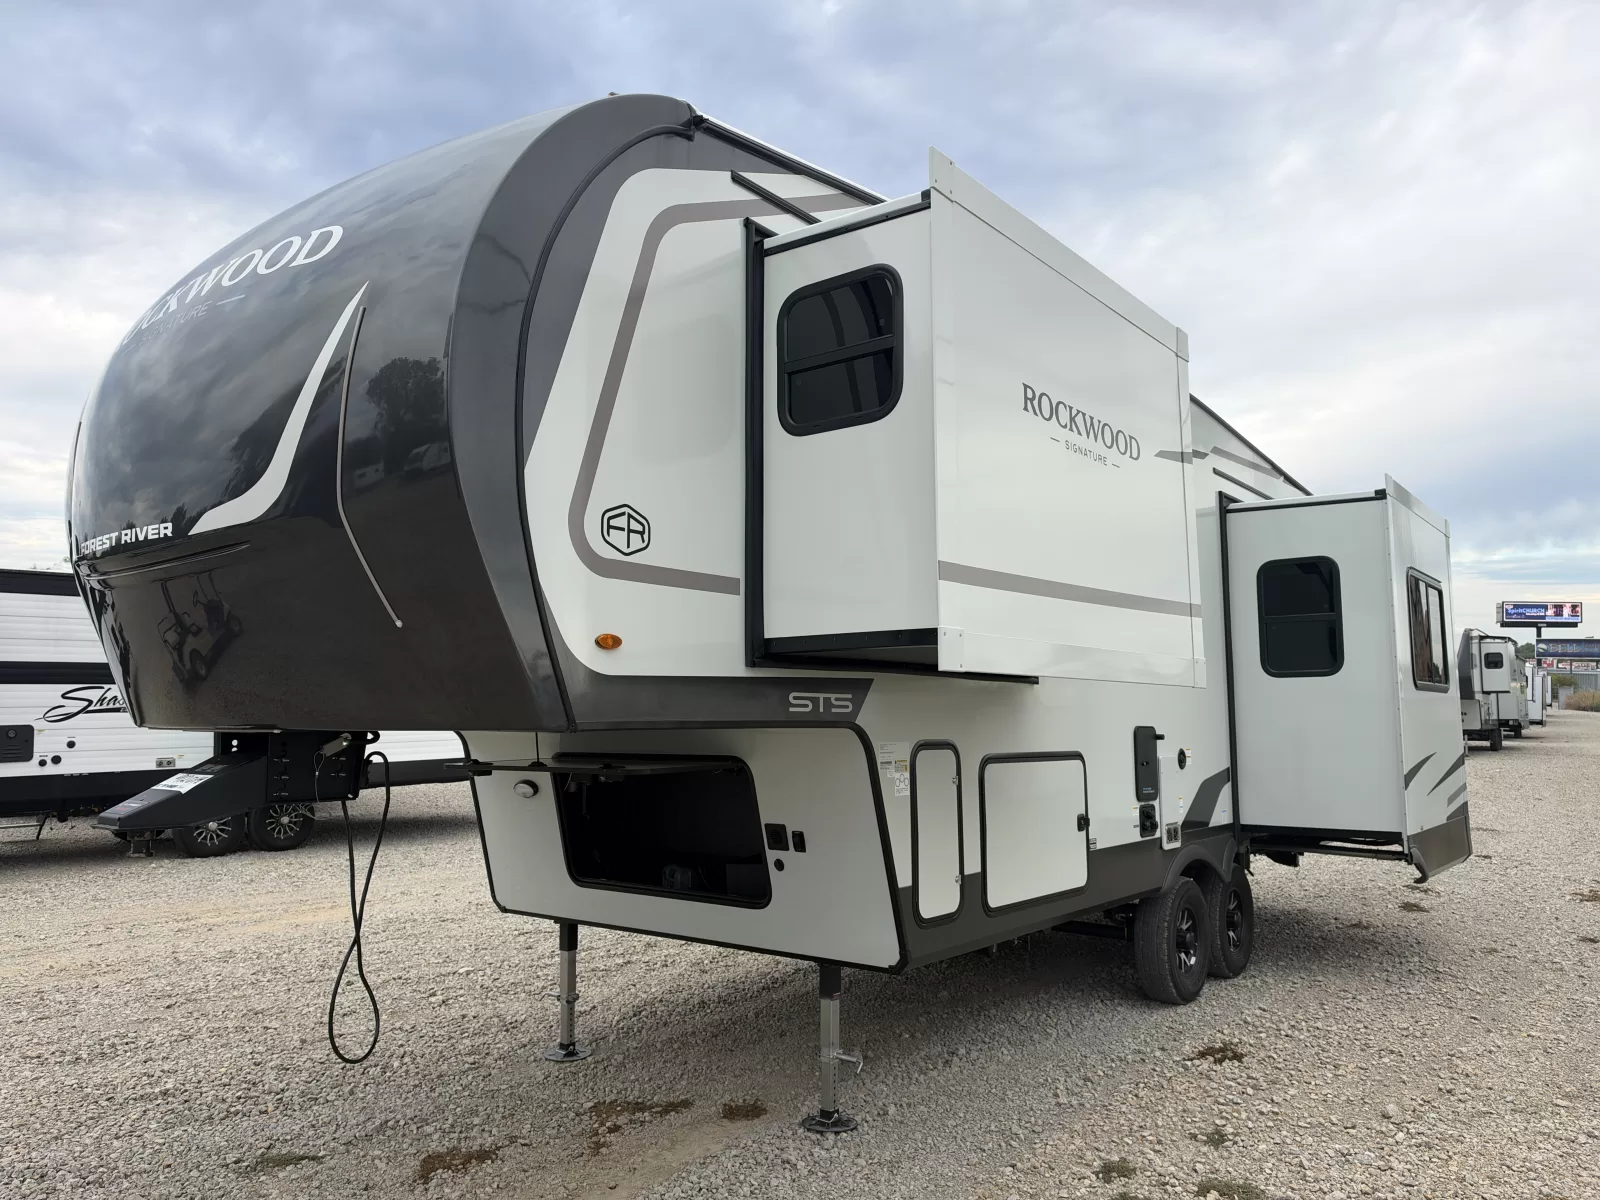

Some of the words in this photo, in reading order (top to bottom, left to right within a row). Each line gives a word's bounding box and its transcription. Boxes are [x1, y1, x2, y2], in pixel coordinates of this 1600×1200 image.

[119, 225, 344, 346] OCKWOOD
[1022, 382, 1141, 461] ROCKWOOD
[1065, 440, 1108, 466] SIGNATURE
[81, 531, 119, 556] FOREST
[121, 522, 173, 544] RIVER
[788, 692, 853, 712] STS
